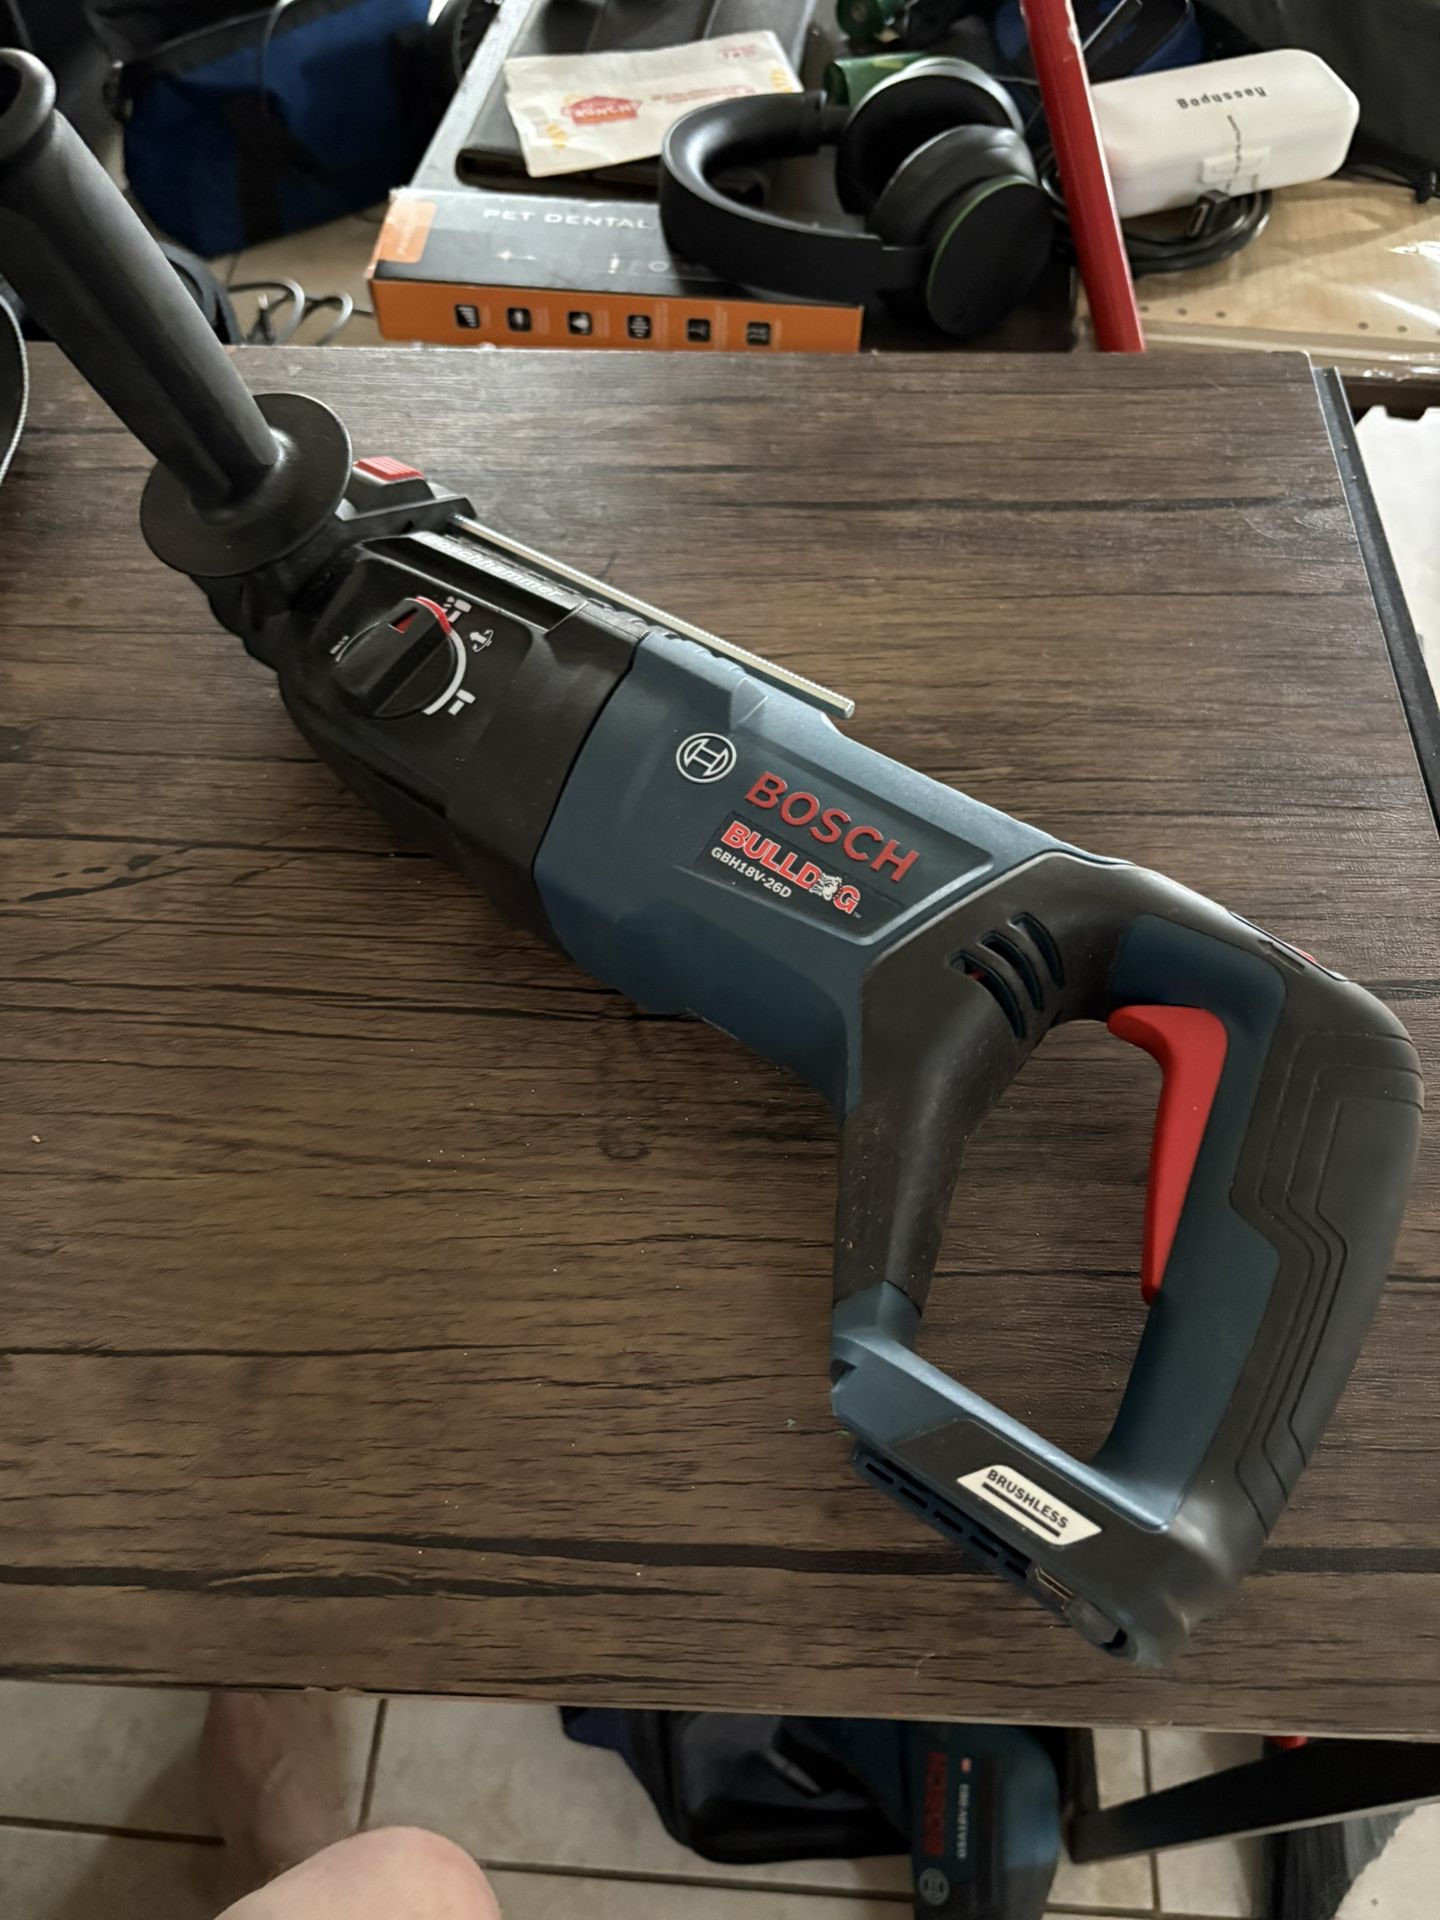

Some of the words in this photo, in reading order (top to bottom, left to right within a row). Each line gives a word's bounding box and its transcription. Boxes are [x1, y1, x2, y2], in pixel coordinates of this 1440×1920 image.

[1177, 86, 1267, 110] Bodyssey
[483, 208, 535, 222] PET
[544, 213, 651, 229] DENTAL
[421, 534, 564, 597] Boschhammer
[744, 771, 920, 882] BOSCH
[710, 847, 793, 899] GBH18V-26D
[986, 1468, 1069, 1529] BRUSHLESS
